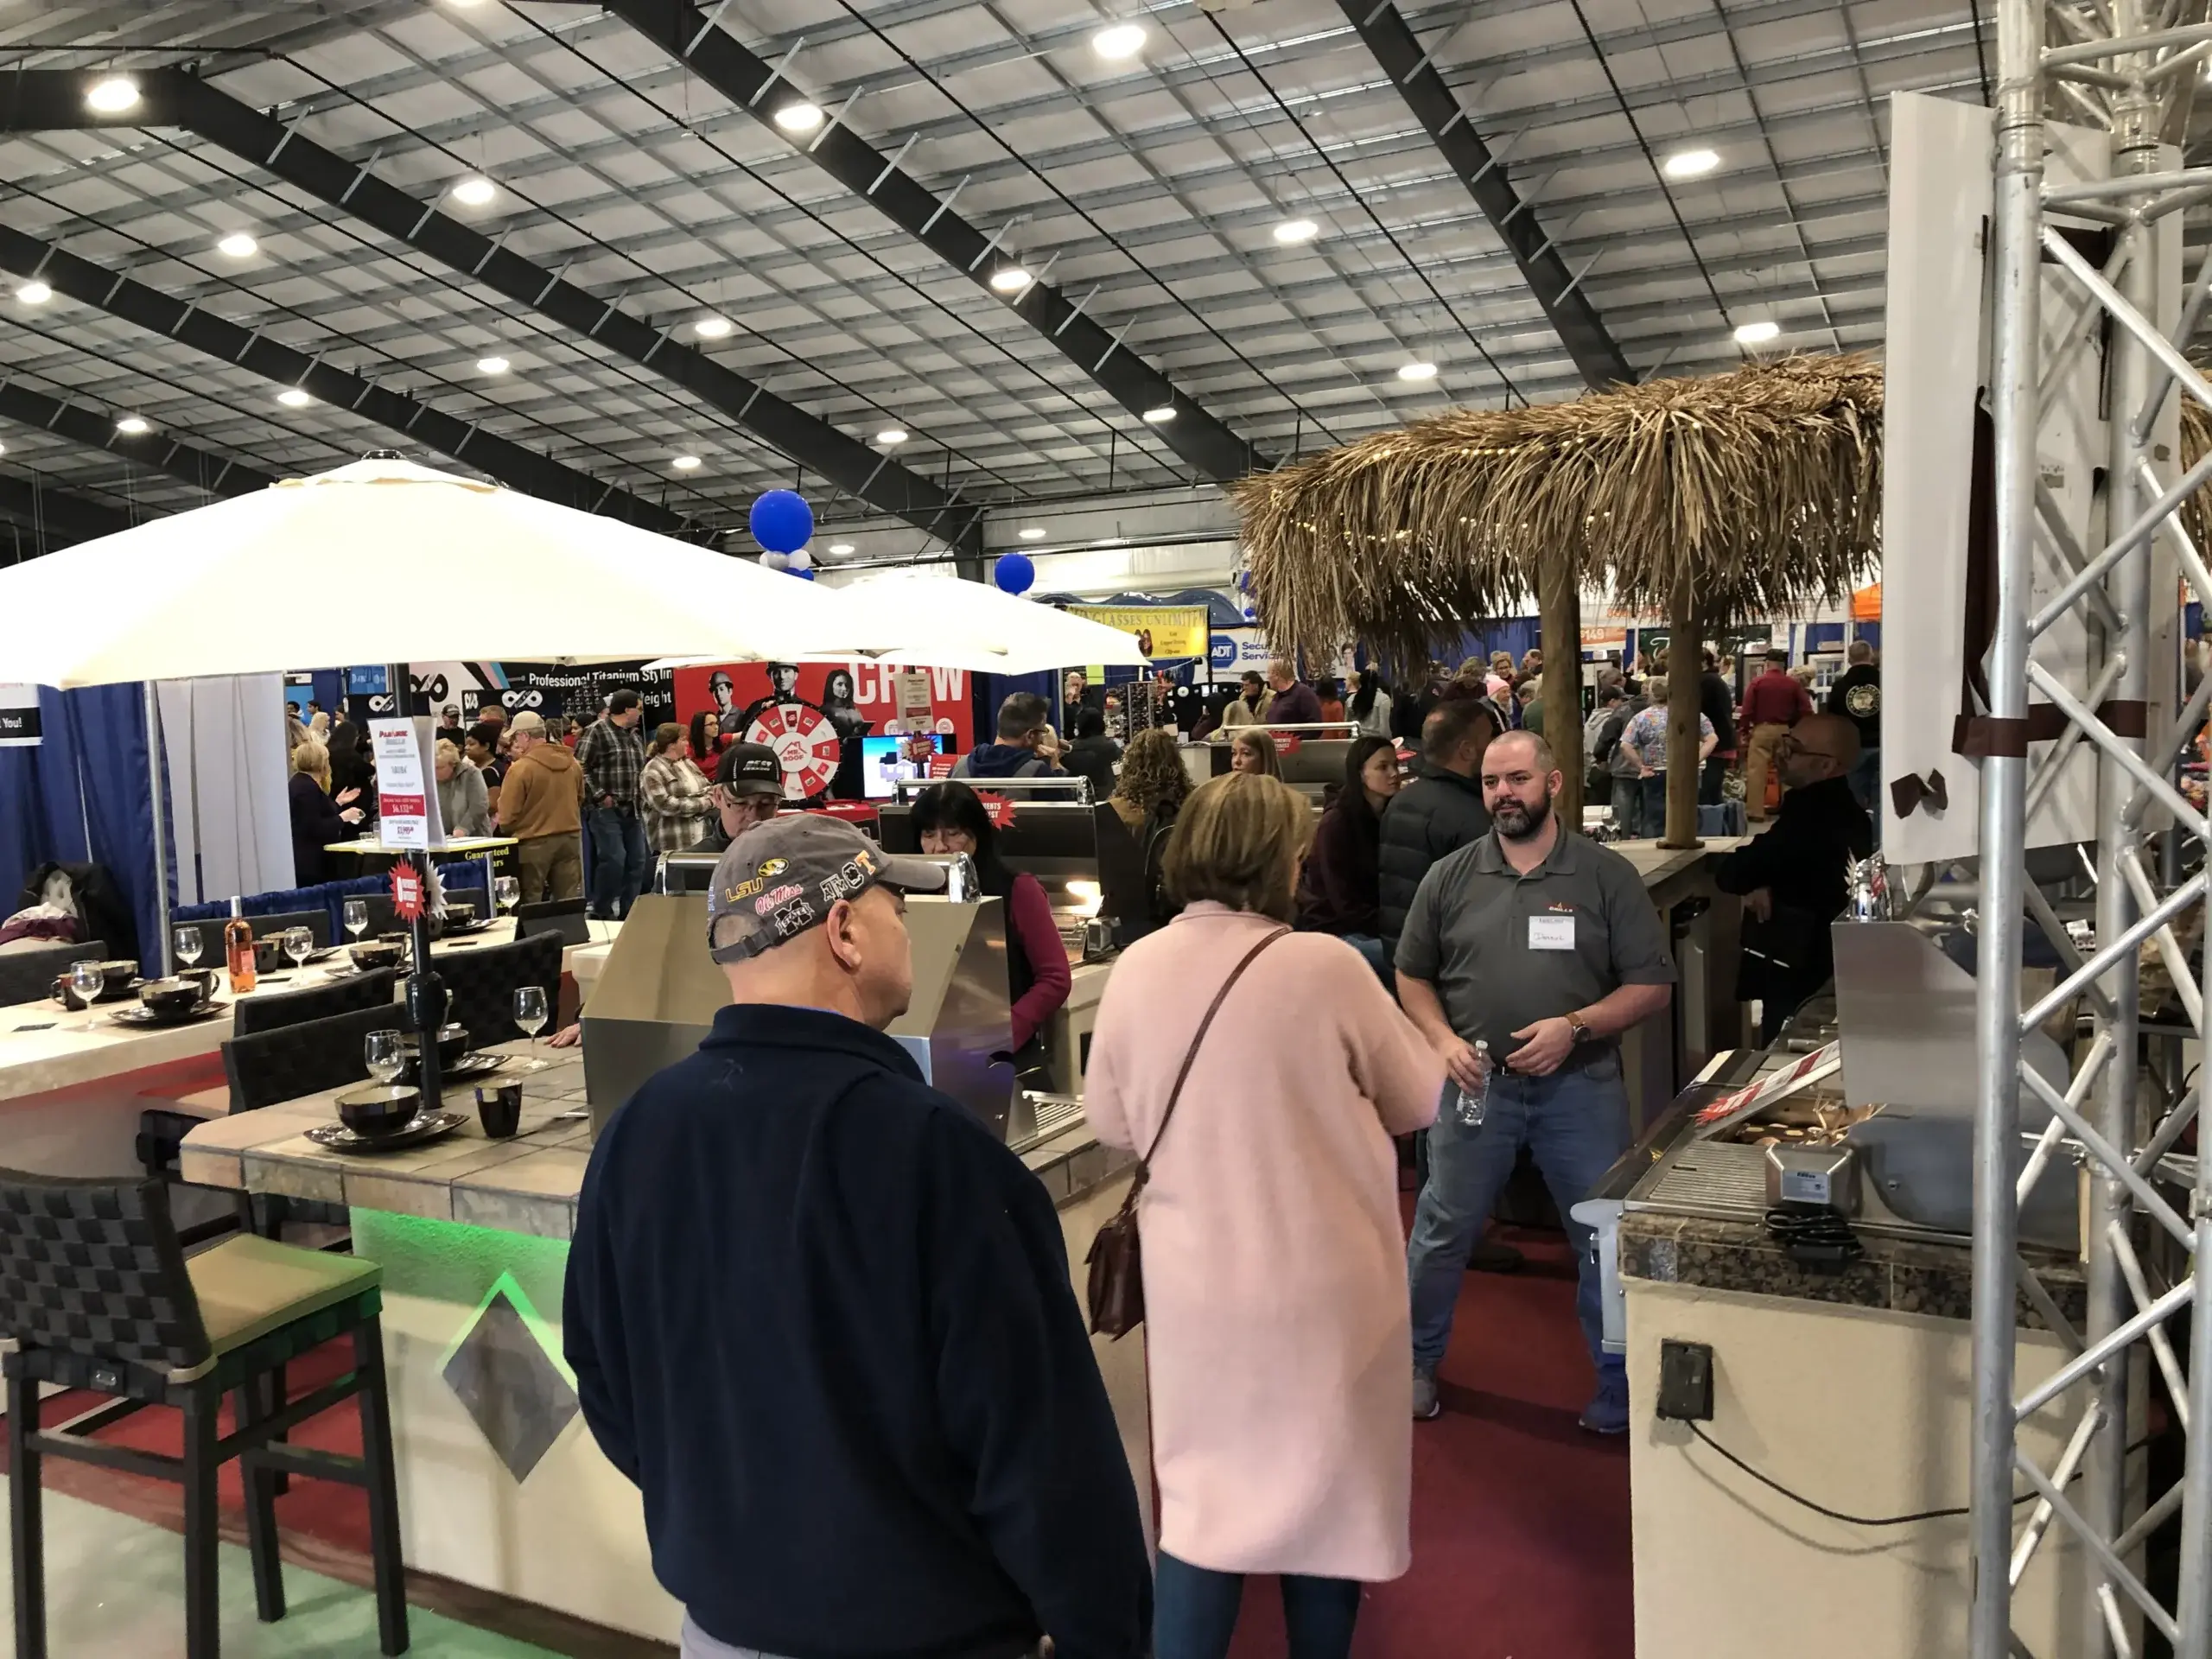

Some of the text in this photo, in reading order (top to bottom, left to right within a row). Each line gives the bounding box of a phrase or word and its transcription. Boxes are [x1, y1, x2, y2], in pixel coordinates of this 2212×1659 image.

[1211, 645, 1232, 657] ADT
[529, 668, 673, 688] Professional Titanium Stylin
[849, 663, 964, 704] CRW
[3, 716, 22, 728] You!
[465, 847, 510, 861] Guarteed
[725, 877, 763, 903] LSU
[755, 884, 804, 916] Ole Miss
